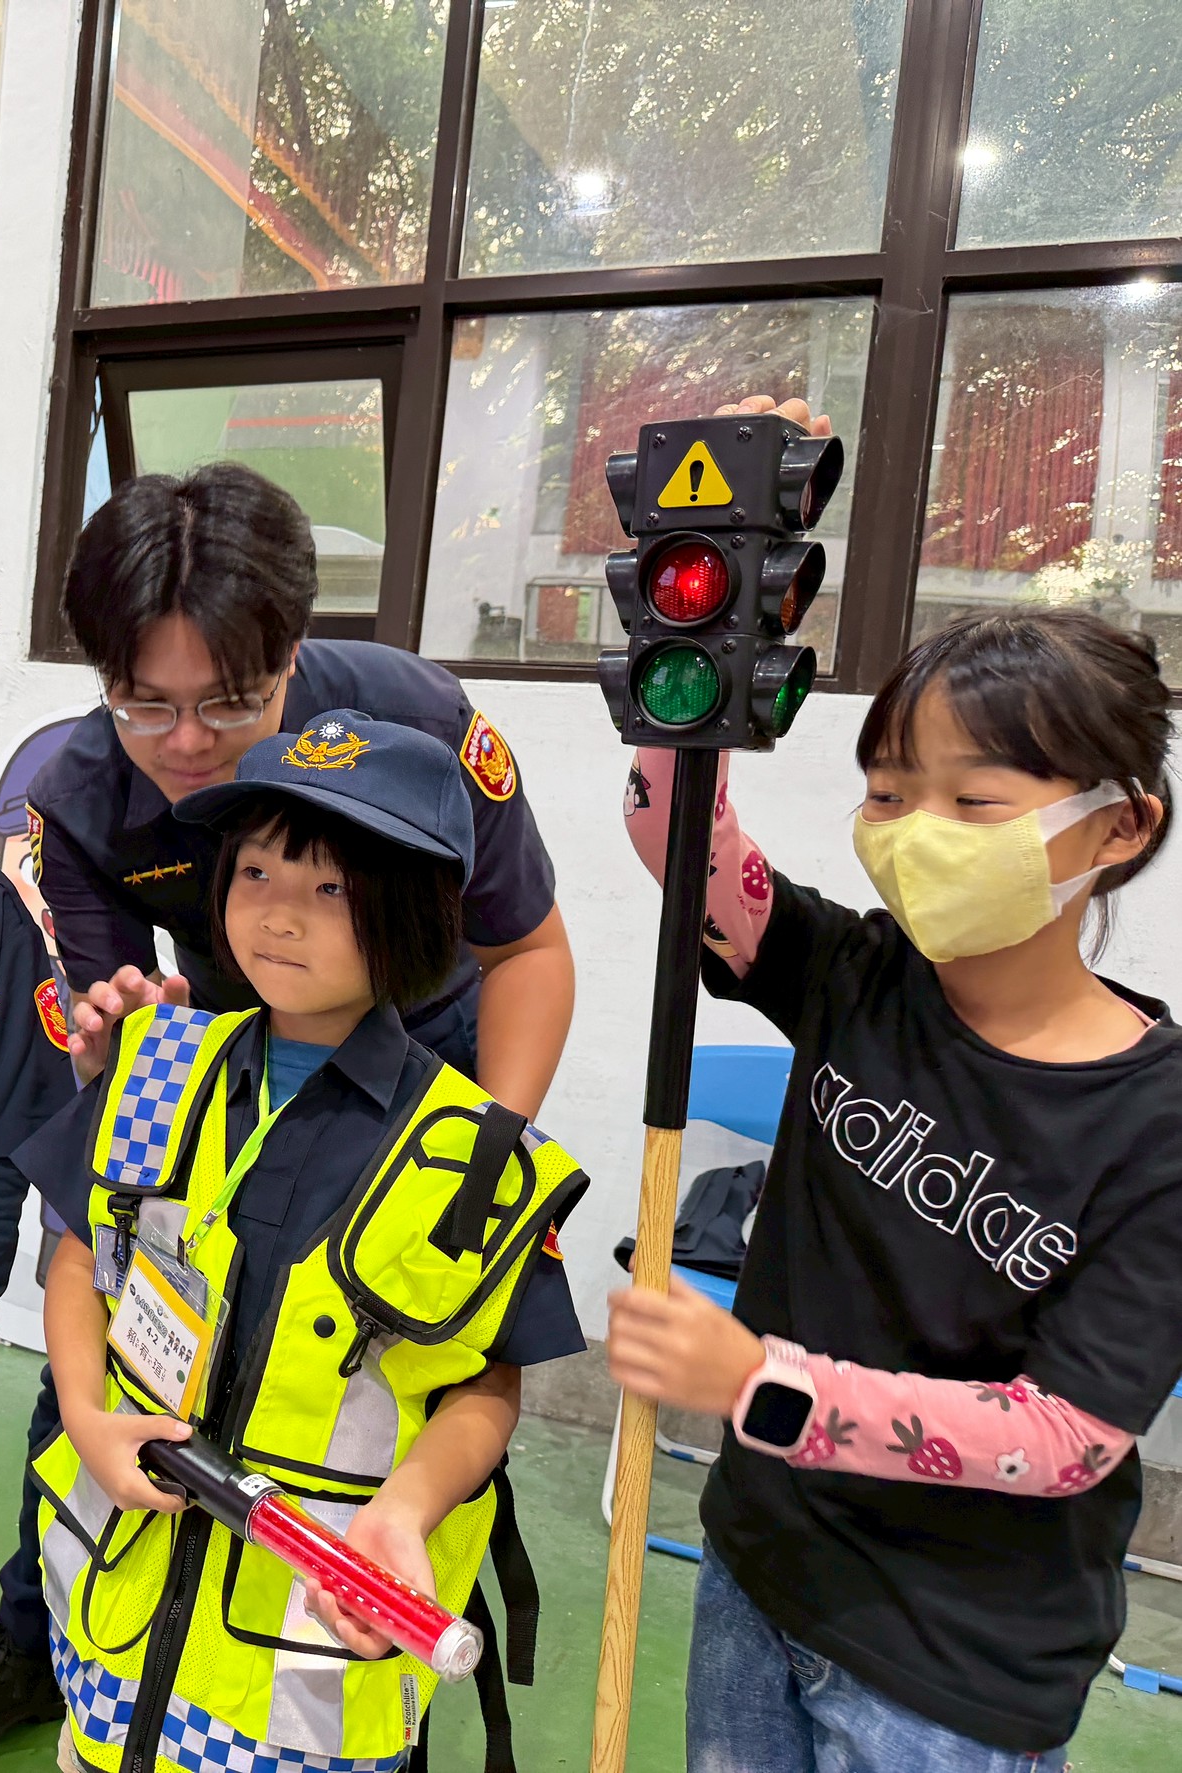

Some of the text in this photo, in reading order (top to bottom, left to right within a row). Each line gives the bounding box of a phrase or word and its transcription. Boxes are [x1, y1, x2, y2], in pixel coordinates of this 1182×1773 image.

[810, 1062, 1078, 1292] adidas
[146, 1327, 159, 1346] 4-2
[405, 1727, 412, 1740] 3M
